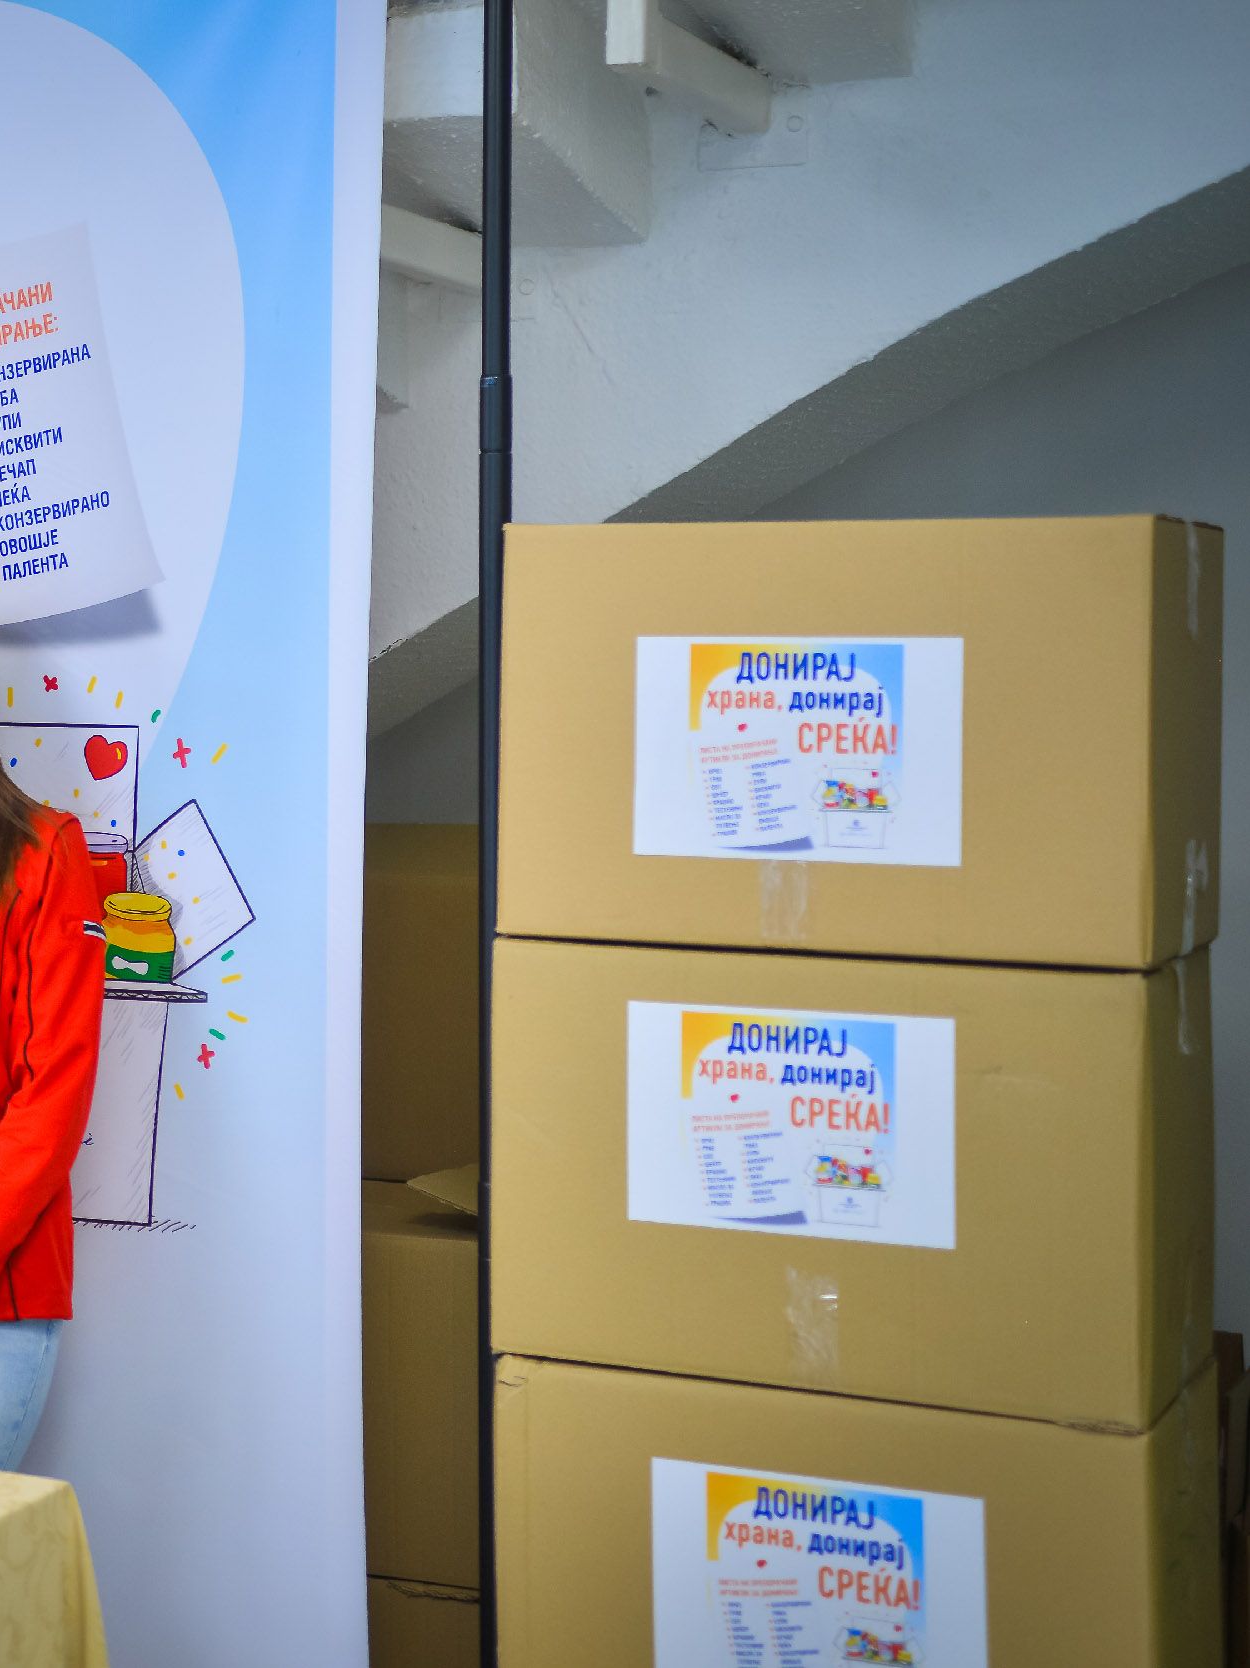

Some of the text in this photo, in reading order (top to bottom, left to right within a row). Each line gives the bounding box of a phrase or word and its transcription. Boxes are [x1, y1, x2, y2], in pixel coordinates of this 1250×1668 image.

[2, 551, 70, 582] ПАЛЕНТА
[736, 652, 856, 684] ДОНИРАЈ
[707, 686, 884, 717] храна, донирај
[798, 717, 898, 755] СРЕЌА!
[727, 1022, 847, 1057] ДОНИРАЈ
[699, 1058, 875, 1094] храна, донирај
[790, 1093, 890, 1134] СРЕЌА!
[753, 1486, 875, 1530] ДОНИРАЈ
[724, 1521, 904, 1570] храна, донирај
[818, 1566, 921, 1611] СРЕЌА!
